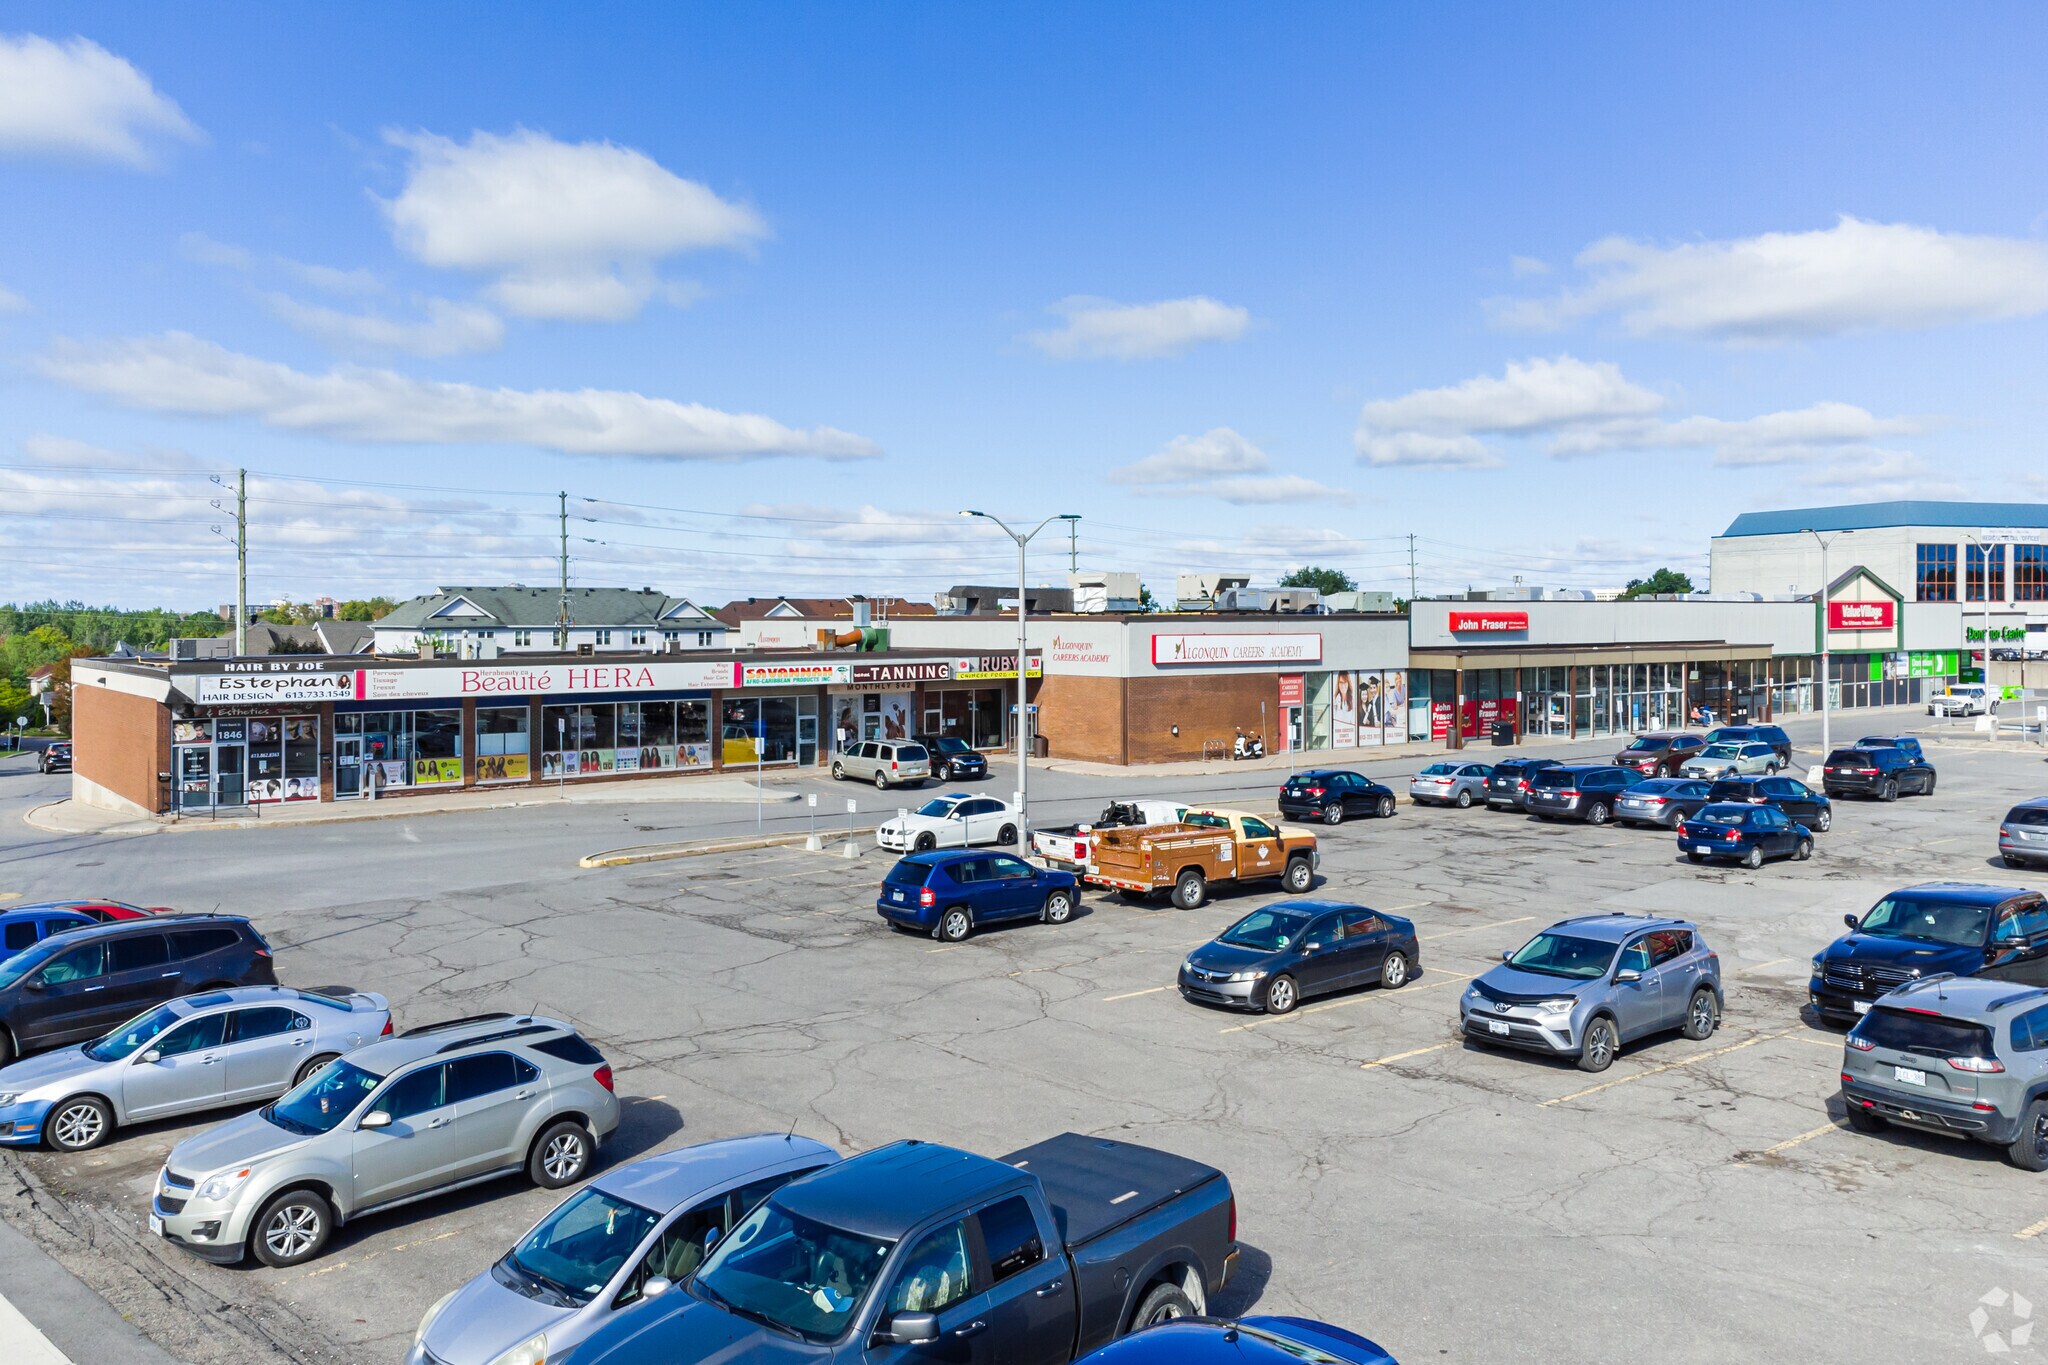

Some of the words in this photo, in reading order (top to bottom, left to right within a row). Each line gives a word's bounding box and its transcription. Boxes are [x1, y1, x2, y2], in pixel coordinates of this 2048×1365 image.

[1458, 619, 1478, 630] John
[1481, 619, 1507, 629] Fraser
[1174, 636, 1229, 660] ALGONQUIN
[1233, 646, 1265, 658] CAREERS
[1268, 646, 1304, 658] ACADEMY
[981, 656, 1018, 672] RUBY
[1080, 655, 1110, 663] ACADEMY
[224, 663, 263, 672] HAIR
[270, 663, 290, 671] BY
[296, 662, 324, 671] JOE
[746, 667, 832, 679] SAVANNAH
[870, 664, 949, 681] TANNING
[219, 676, 334, 692] Estephan
[461, 670, 551, 692] Beauté
[568, 667, 655, 689] HERA
[847, 682, 891, 690] MONTHLY
[202, 693, 230, 701] HAIR
[233, 692, 274, 700] DESIGN
[285, 690, 350, 699] 613.733.1549
[1435, 703, 1451, 712] John
[1481, 701, 1496, 709] John
[1432, 712, 1453, 721] Fraser
[1479, 709, 1498, 718] Fraser
[218, 731, 243, 740] 1846
